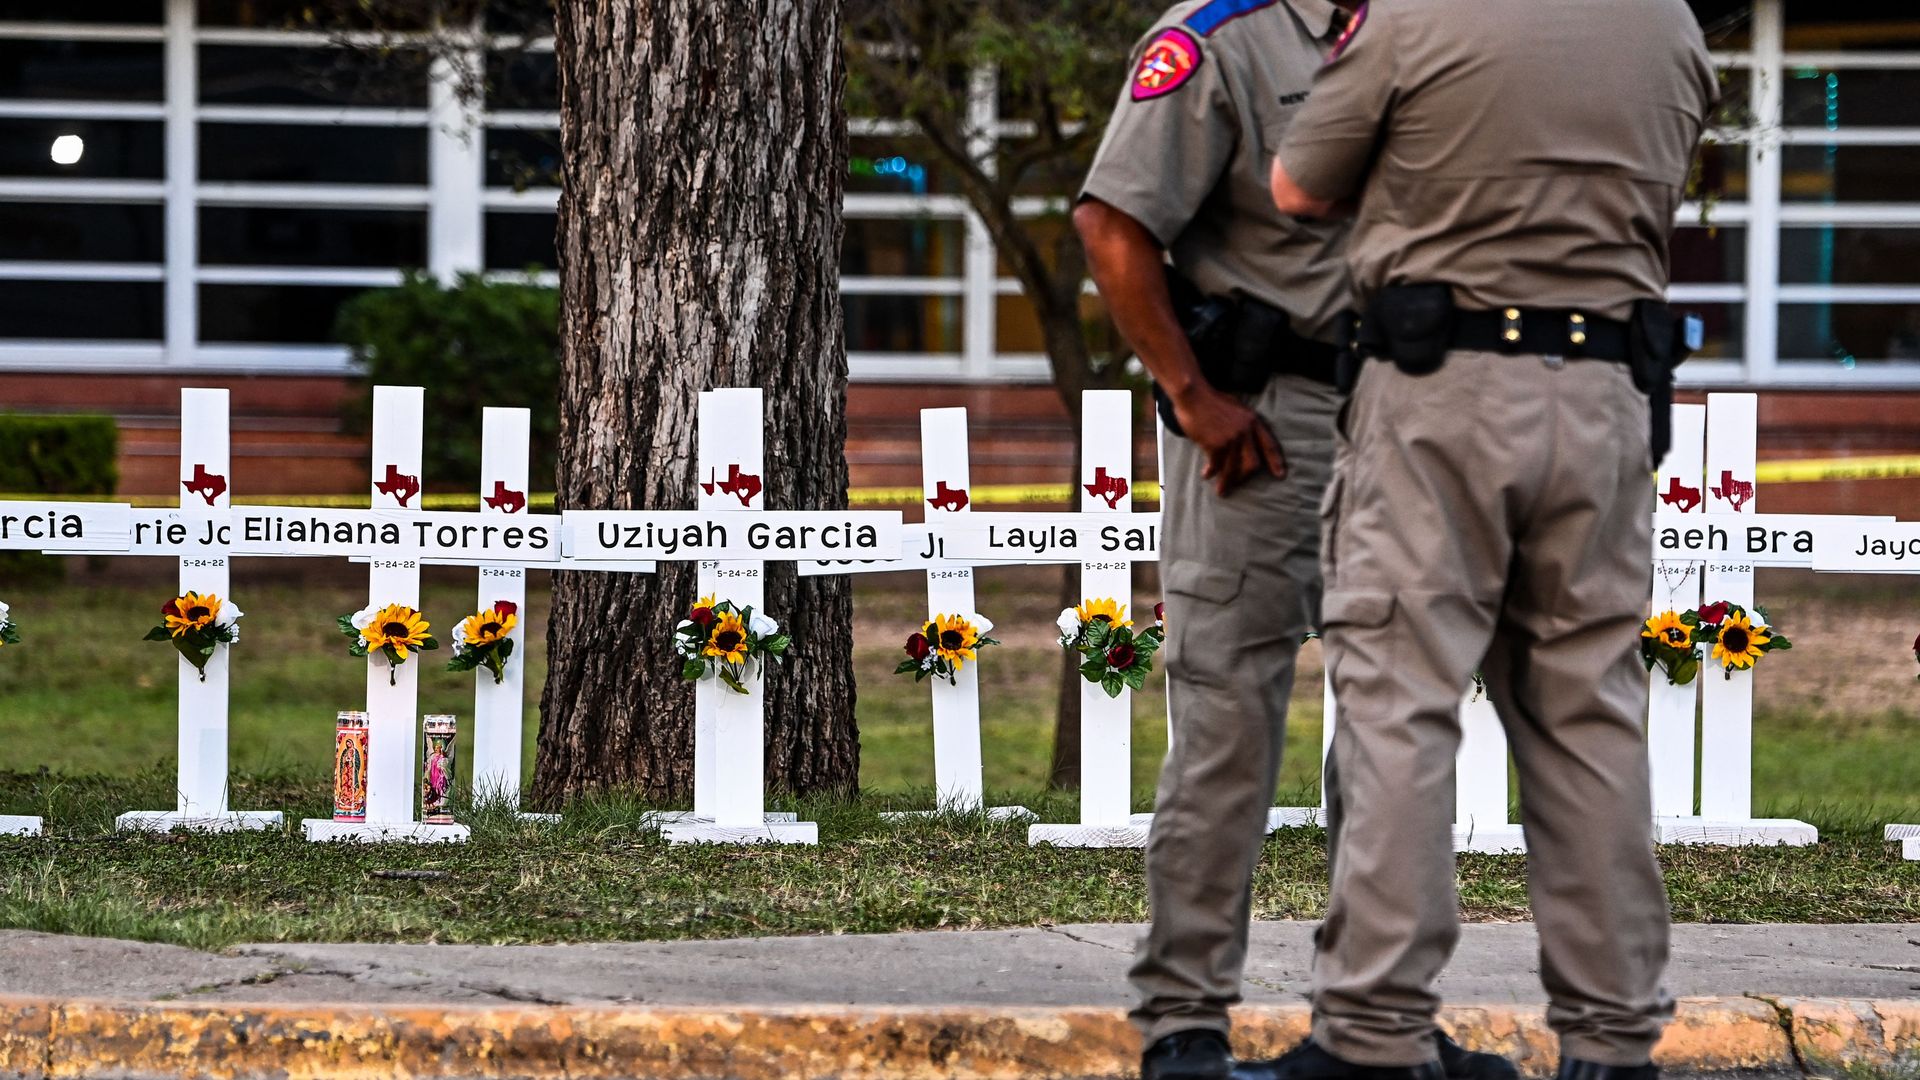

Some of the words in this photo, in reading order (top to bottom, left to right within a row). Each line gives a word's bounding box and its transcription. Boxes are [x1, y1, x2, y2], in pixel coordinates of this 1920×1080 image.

[1, 510, 83, 539] rcia
[129, 519, 187, 545] rie
[244, 516, 400, 544] Eliahana
[412, 521, 549, 549] Torres
[598, 520, 727, 554] Uziyah
[747, 521, 877, 550] Garcia
[989, 525, 1078, 553] Layla
[1100, 525, 1156, 552] Sal
[1652, 524, 1728, 551] aeh
[1746, 526, 1813, 553] Bra
[183, 559, 224, 567] 5-24-22
[374, 560, 416, 569] 5-24-22
[1085, 562, 1127, 570] 5-24-22
[482, 568, 522, 578] 5-24-22
[1657, 567, 1697, 575] 5-24-22
[1710, 564, 1751, 573] 5-24-22
[717, 569, 758, 578] 5-24-22
[931, 570, 969, 579] 5-24-22
